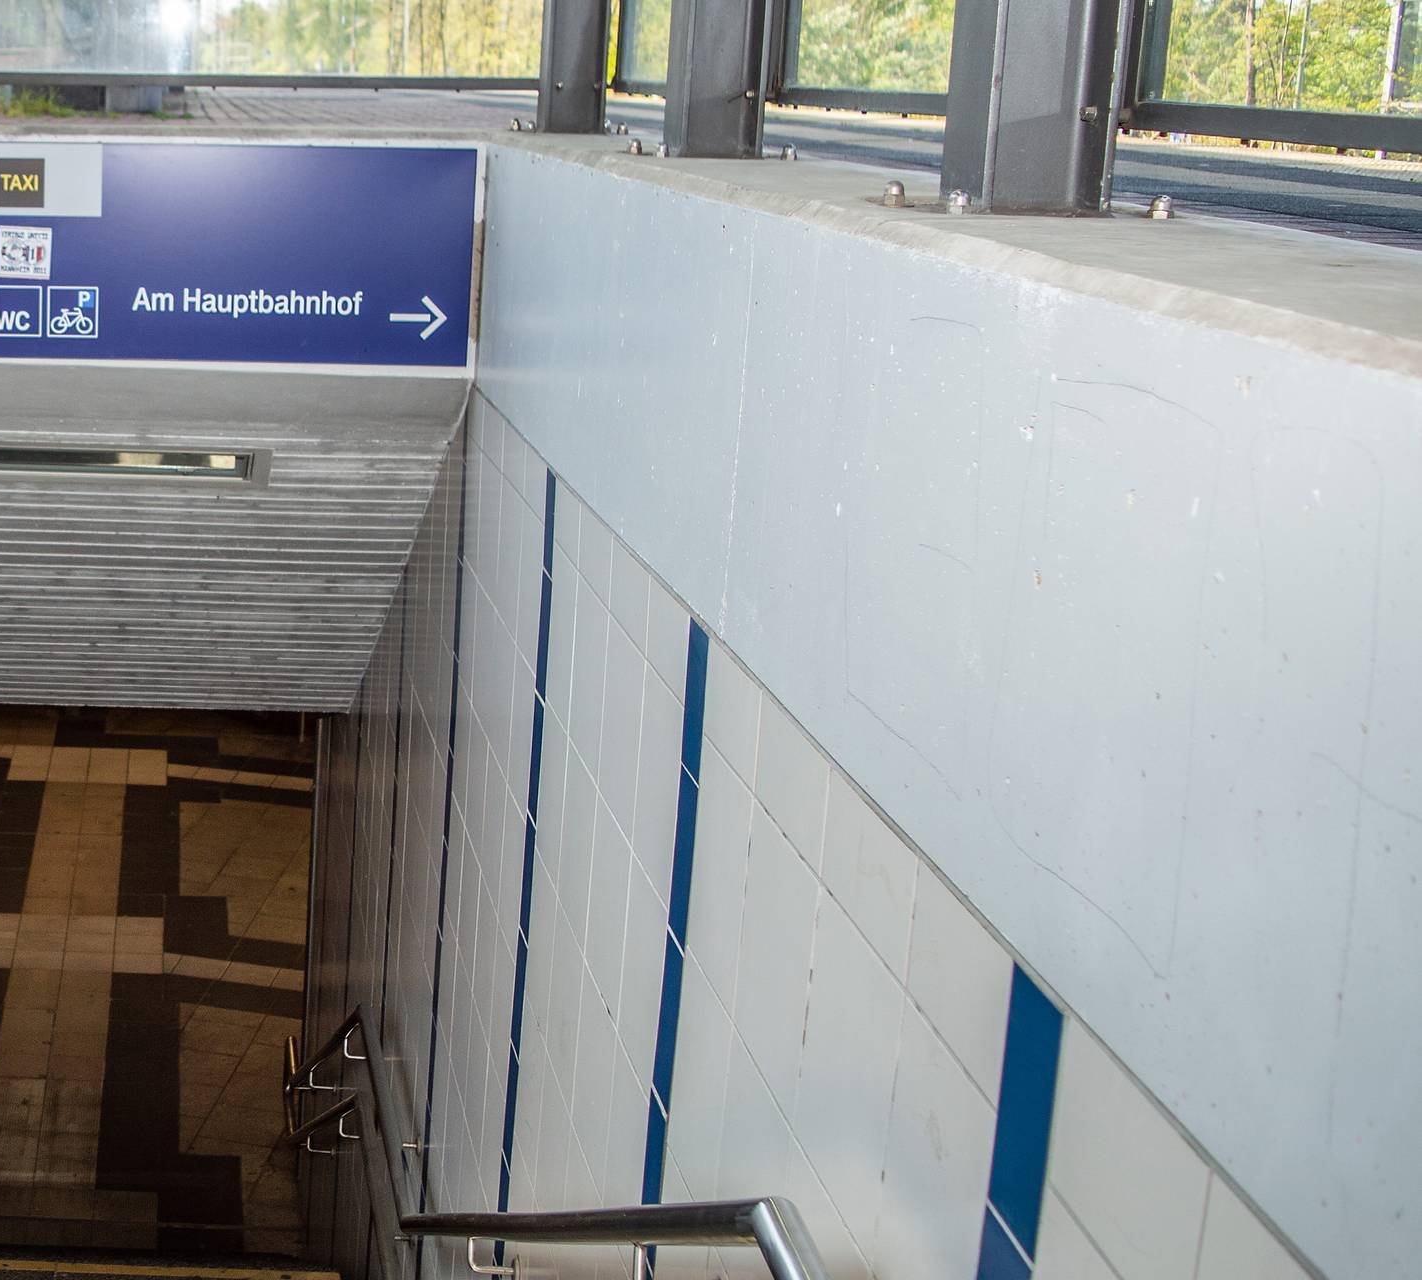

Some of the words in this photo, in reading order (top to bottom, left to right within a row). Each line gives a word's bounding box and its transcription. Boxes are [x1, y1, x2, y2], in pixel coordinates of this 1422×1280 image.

[0, 174, 39, 192] TAXI
[78, 291, 90, 308] P
[132, 287, 174, 311] Am
[183, 288, 362, 318] Hauptbahnhof
